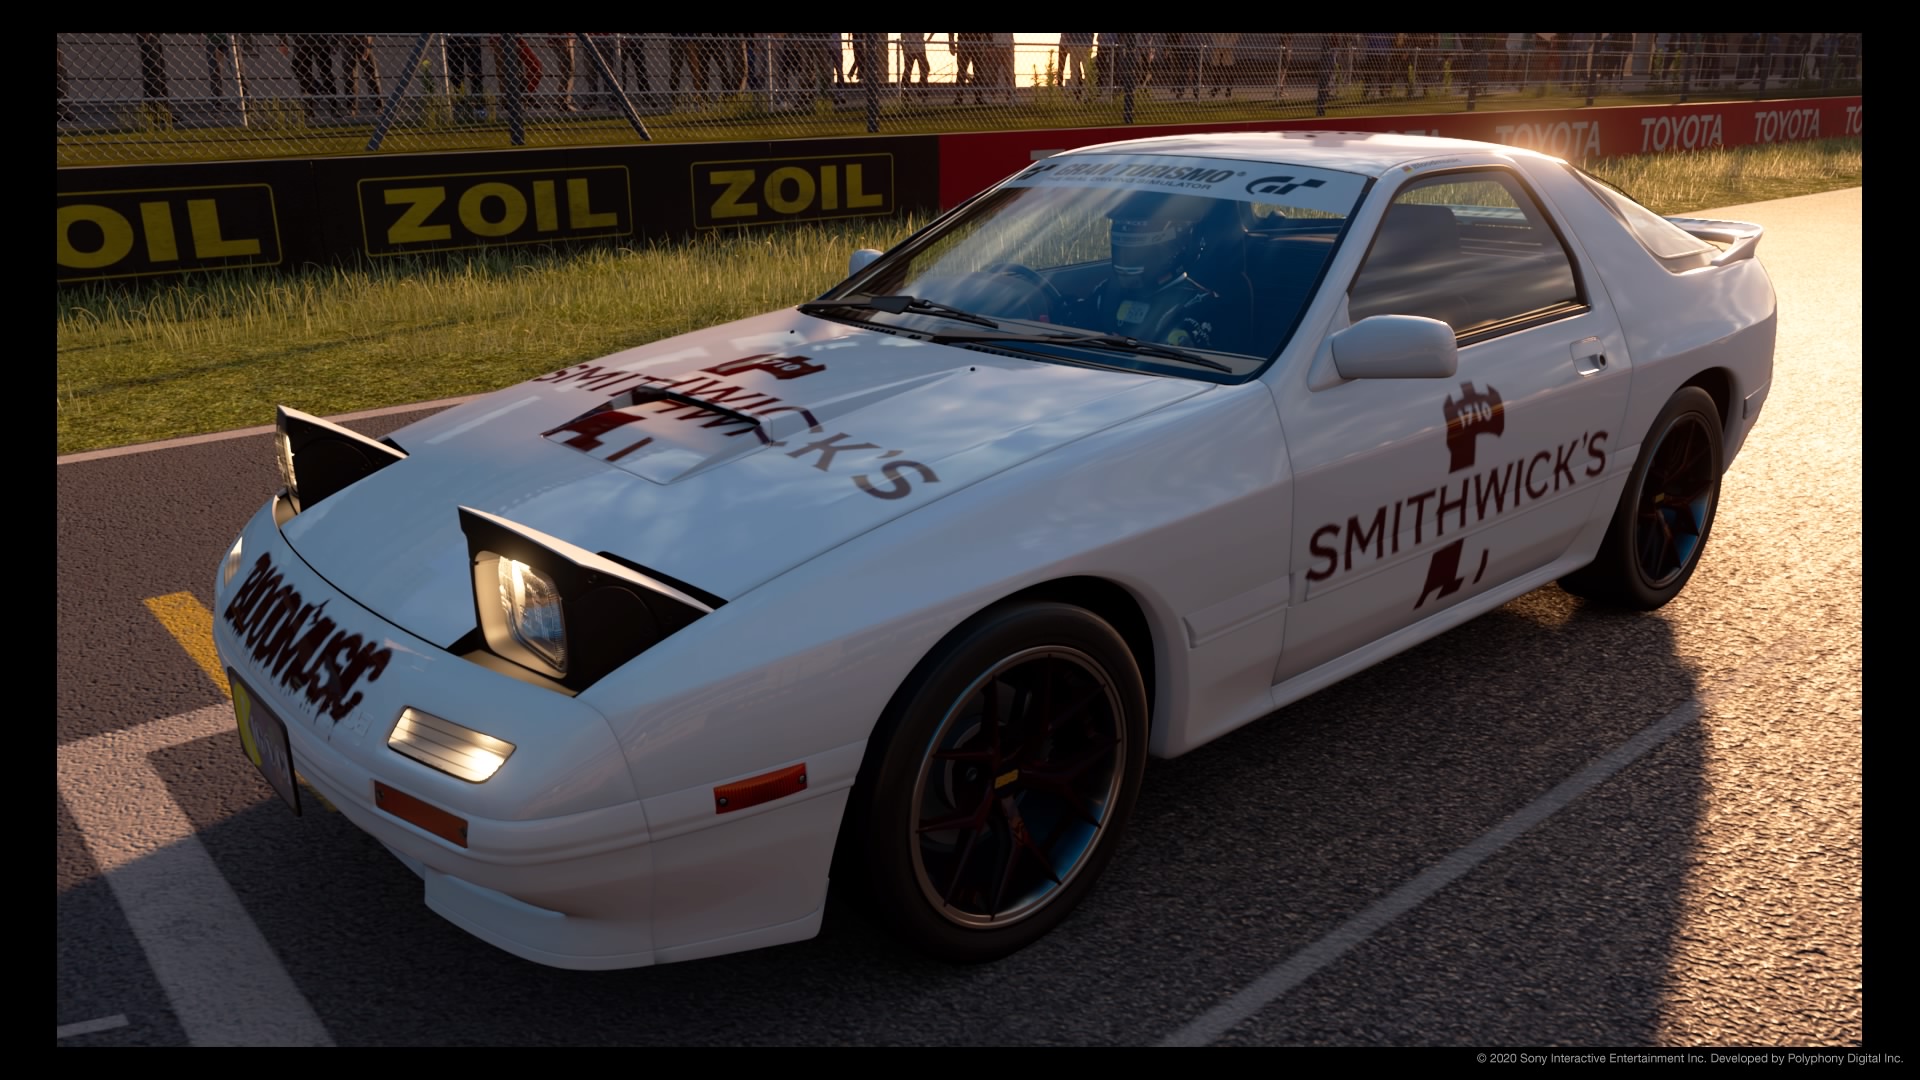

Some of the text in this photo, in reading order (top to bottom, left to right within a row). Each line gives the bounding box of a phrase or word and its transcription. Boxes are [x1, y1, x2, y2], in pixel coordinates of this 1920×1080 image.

[1495, 120, 1601, 158] TOYOTA
[1641, 114, 1723, 152] TOYOTA
[1754, 109, 1820, 143] TOYOTA
[1055, 163, 1119, 177] GRAN
[1135, 178, 1212, 190] SIMULATOR
[709, 163, 884, 219] ZOIL
[383, 178, 619, 244] ZOIL
[532, 364, 940, 500] SMITHWICK'S
[1457, 400, 1492, 430] 1710
[1304, 429, 1609, 582] SMITHWICK'S
